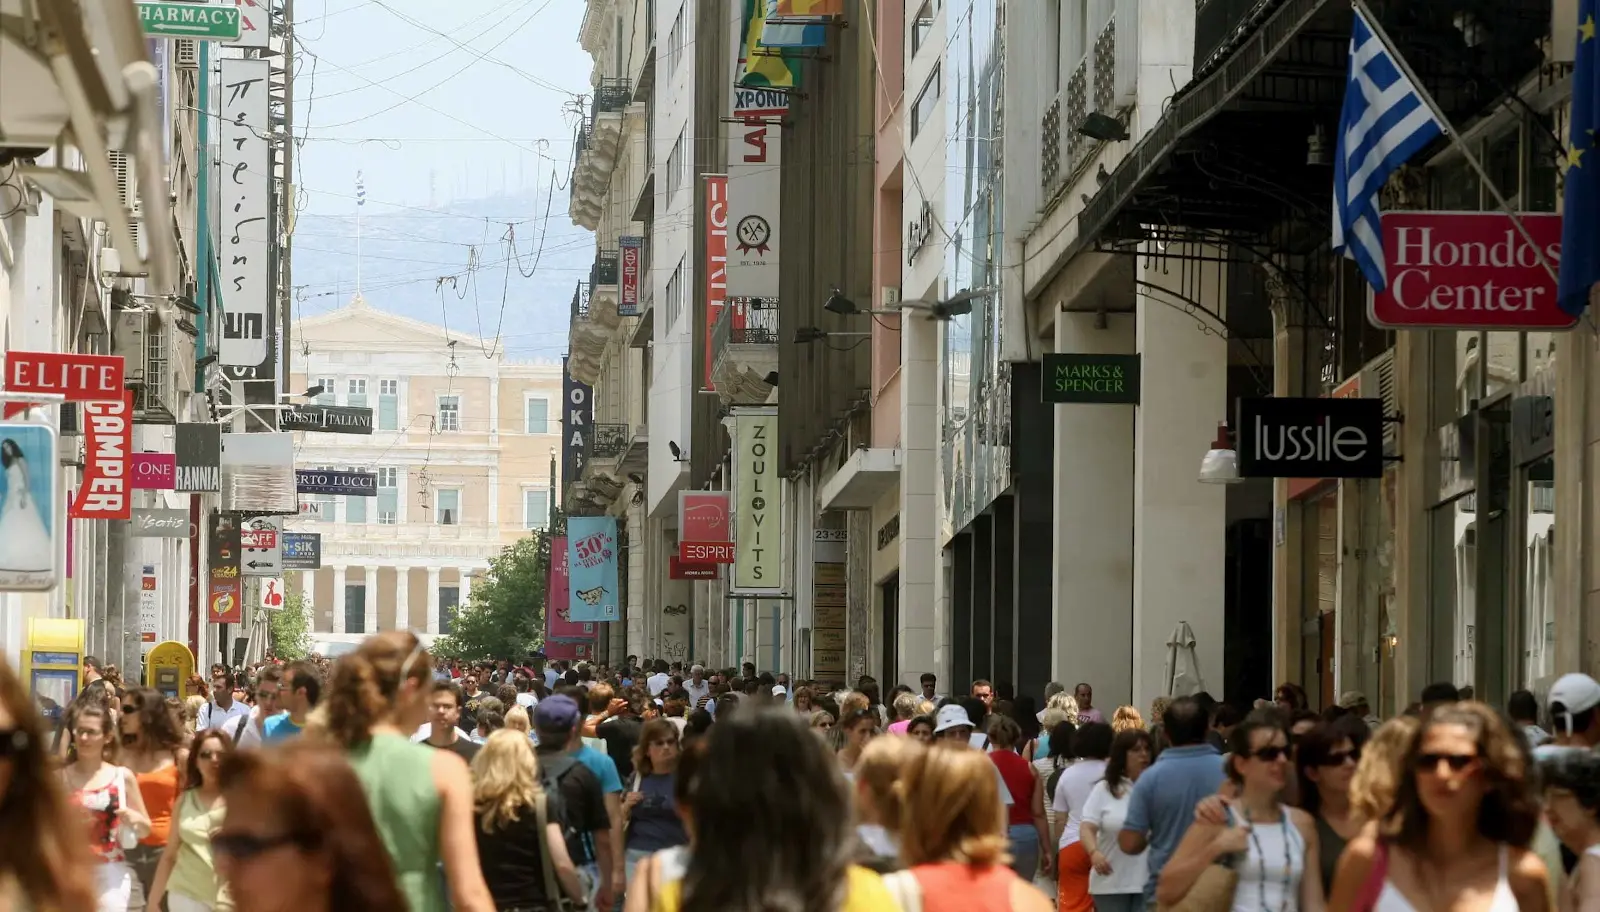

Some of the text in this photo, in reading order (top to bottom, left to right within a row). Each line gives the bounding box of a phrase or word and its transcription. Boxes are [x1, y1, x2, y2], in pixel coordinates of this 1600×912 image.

[1394, 226, 1562, 268] Hondos
[1392, 268, 1545, 312] Center
[13, 360, 117, 391] ELITE
[1055, 379, 1124, 393] SPENCER
[320, 408, 371, 428] ITALIANI
[570, 378, 585, 468] OKA
[1255, 414, 1368, 462] lussile
[82, 401, 125, 511] CAMPER
[138, 461, 171, 475] ONE
[175, 466, 219, 490] RANNIA
[333, 475, 373, 488] LUCCI
[751, 425, 766, 579] ZOULOVITS
[138, 514, 185, 529] Ysatis
[815, 530, 847, 539] 23-25
[575, 531, 612, 559] 50%
[687, 545, 735, 559] ESPRIT
